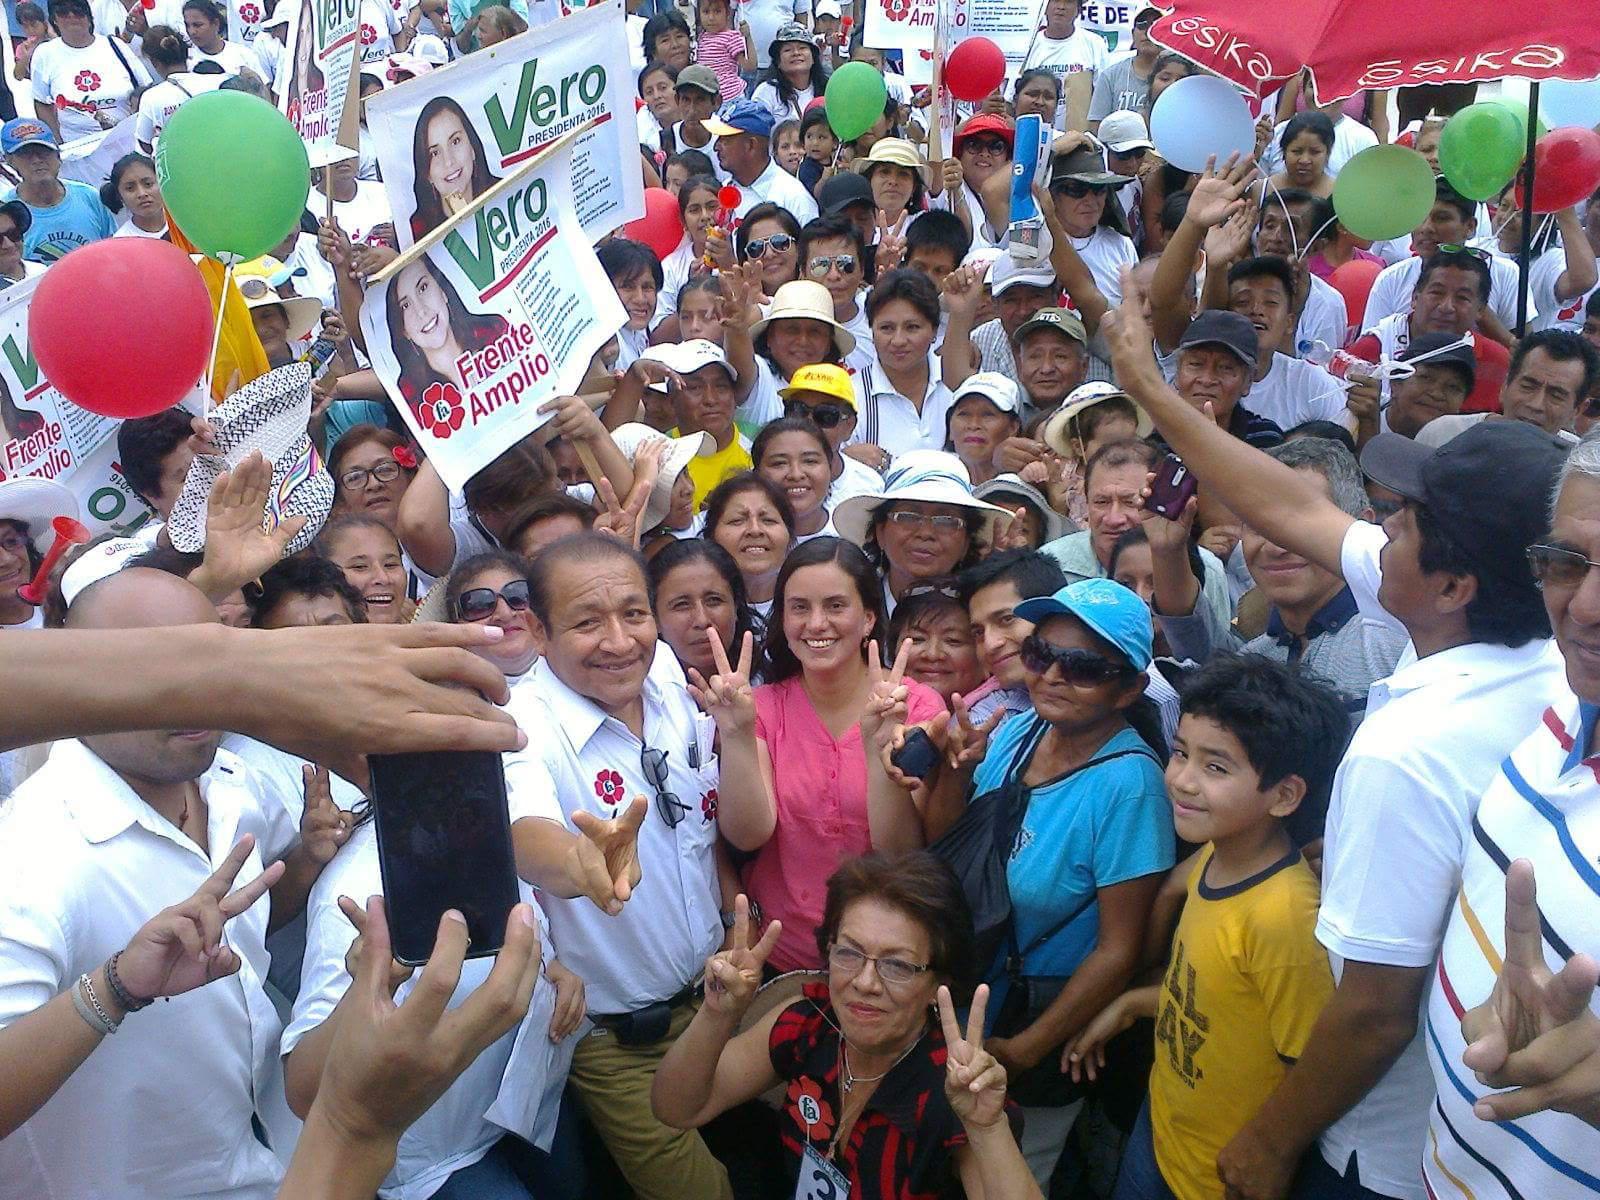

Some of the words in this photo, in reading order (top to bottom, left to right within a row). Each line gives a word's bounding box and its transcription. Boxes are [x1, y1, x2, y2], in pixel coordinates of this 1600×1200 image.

[1105, 6, 1129, 24] DE
[483, 58, 607, 157] Vero
[528, 112, 586, 147] PRESIDENTA
[587, 102, 606, 120] 2016
[443, 178, 547, 291] Vero
[500, 230, 534, 274] PRESIDENTA
[534, 216, 551, 238] 2016
[457, 323, 534, 390] Frente
[469, 353, 549, 426] Amplio
[5, 422, 62, 471] Frente
